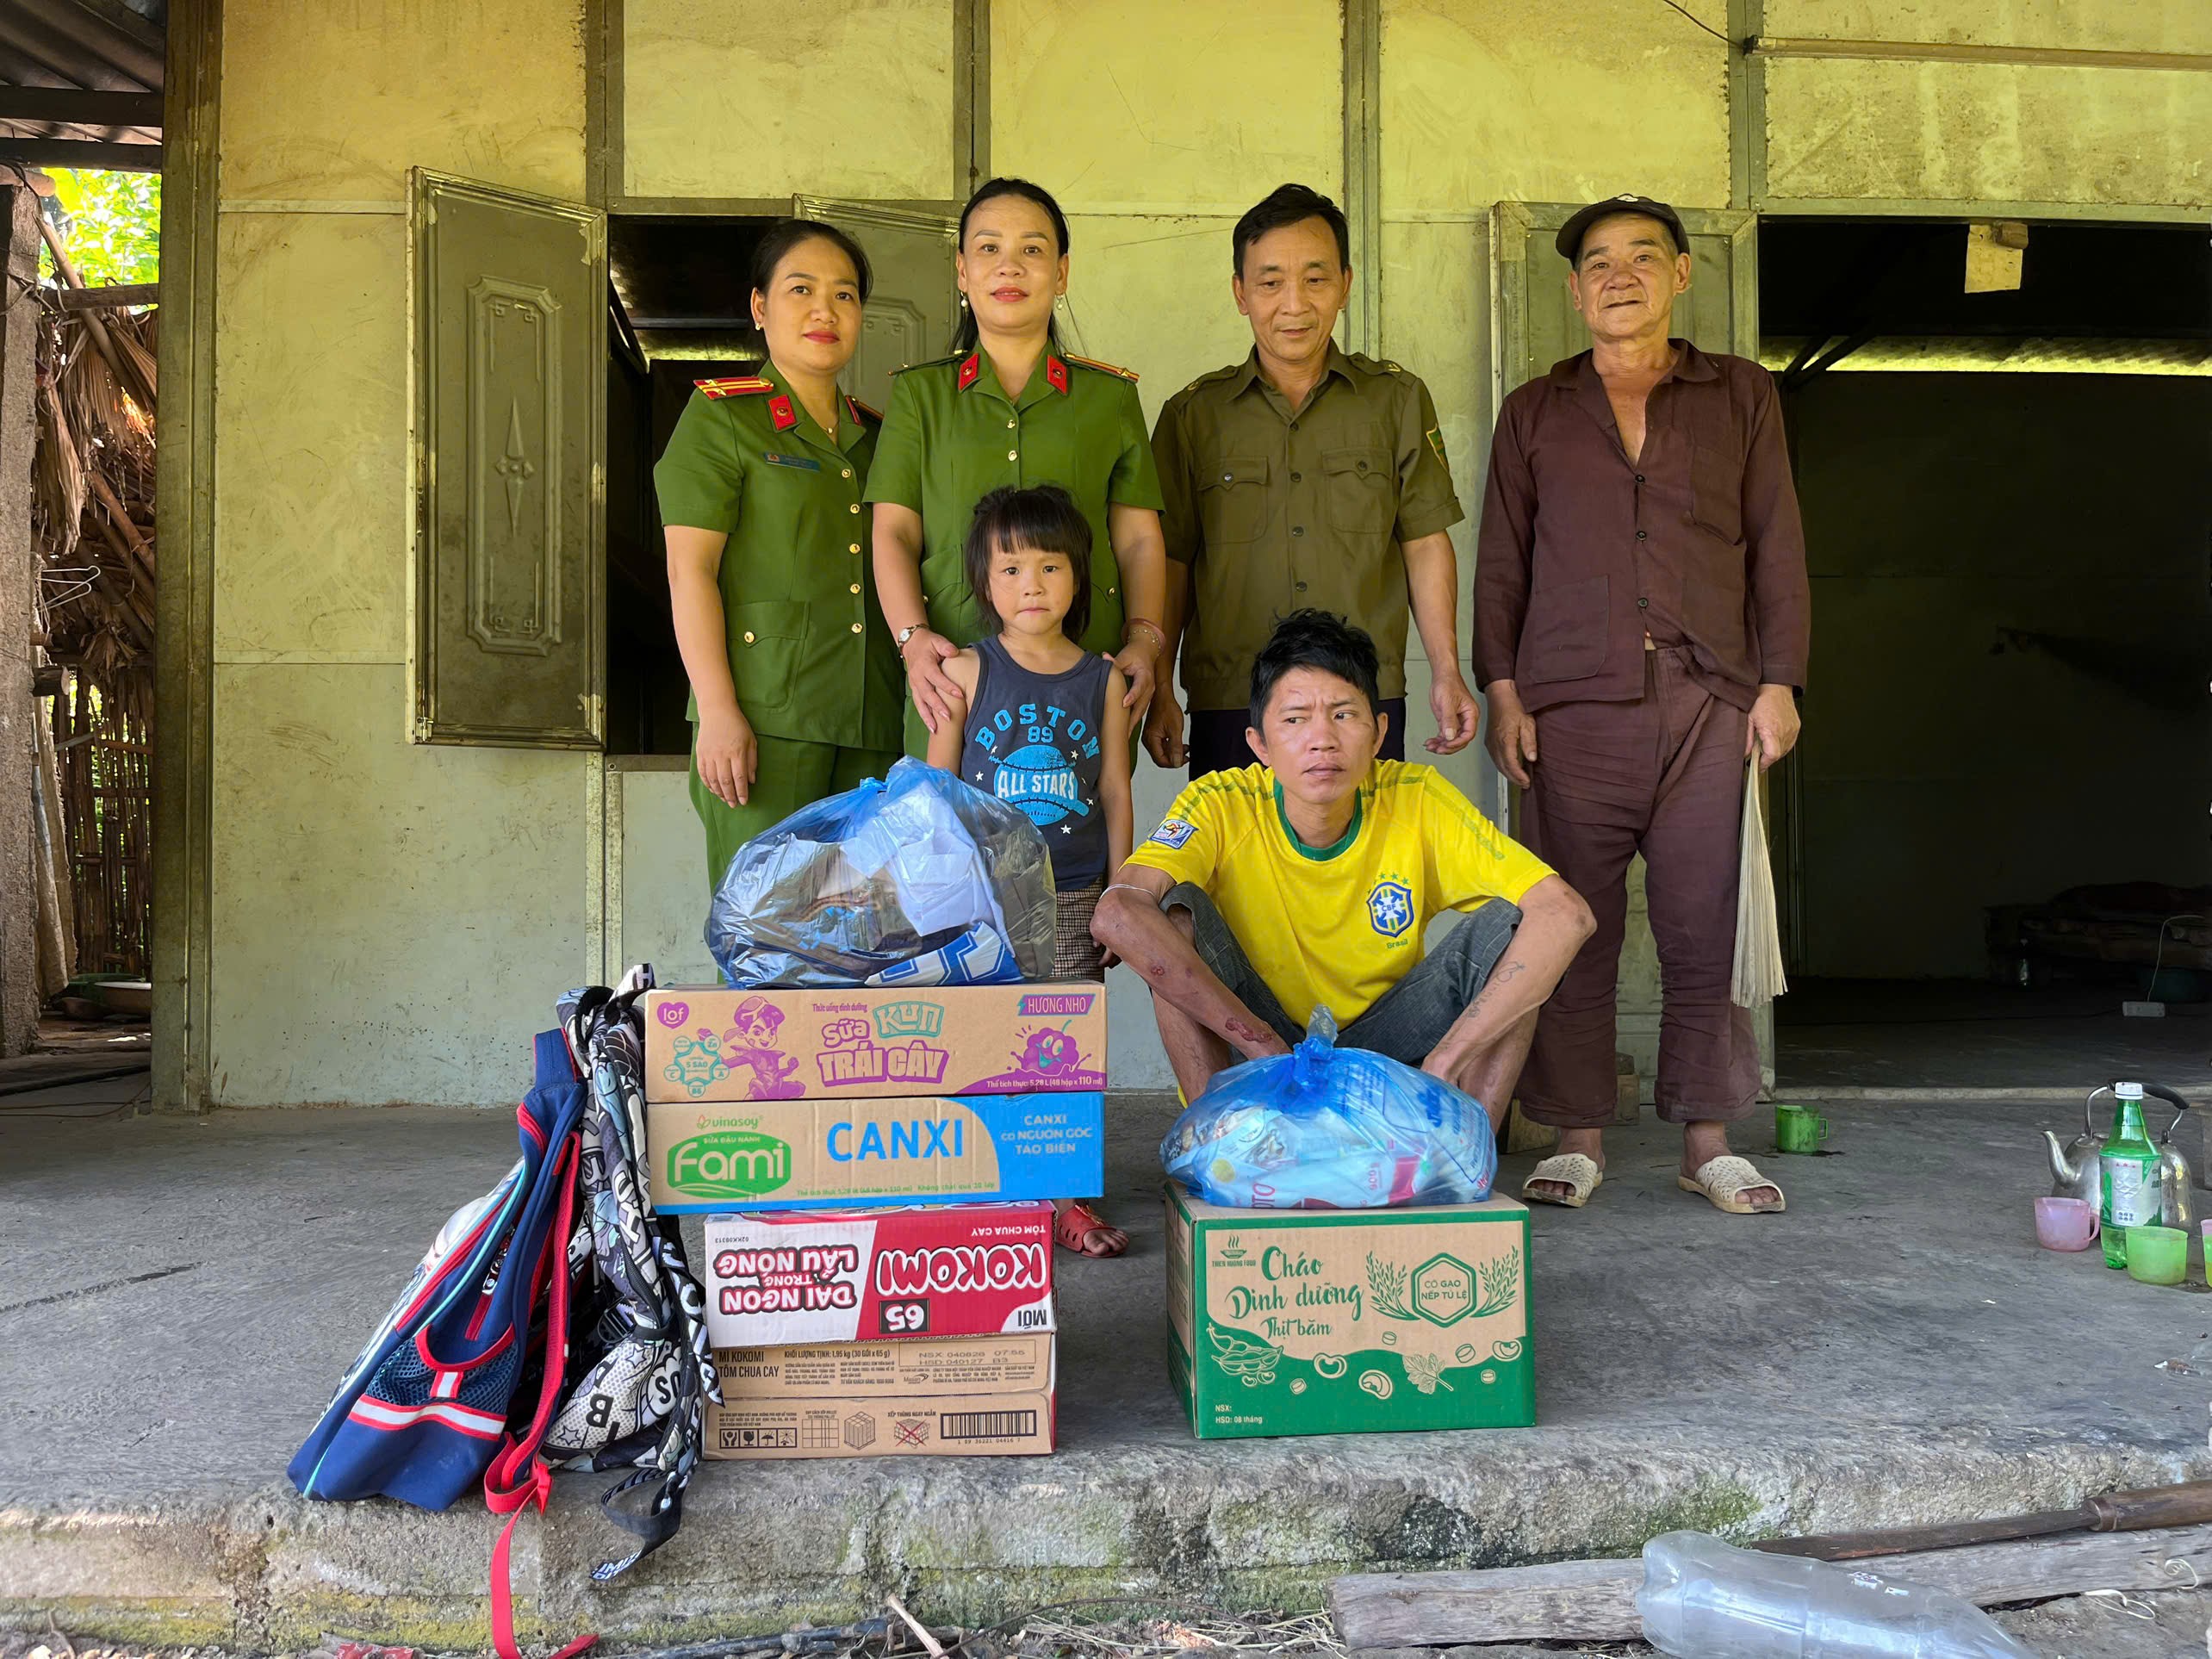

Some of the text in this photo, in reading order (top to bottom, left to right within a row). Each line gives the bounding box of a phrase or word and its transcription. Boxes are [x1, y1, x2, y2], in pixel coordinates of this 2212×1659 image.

[975, 703, 1100, 760] BOSTON
[997, 771, 1076, 800] ALL STARS
[1381, 903, 1396, 912] CBF
[1387, 938, 1408, 949] Brasil
[1028, 996, 1085, 1013] HƯƠNG NHO
[663, 1007, 684, 1022] lof
[817, 1041, 948, 1084] TRÁI CÂY
[1078, 1076, 1091, 1085] 110
[712, 1116, 759, 1129] vinasoy
[1023, 1114, 1067, 1126] CANXI
[826, 1120, 963, 1162] CANXI
[674, 1141, 785, 1183] fami
[971, 1224, 1047, 1237] TÔM CHUA CAY
[716, 1248, 797, 1279] NÓNG
[875, 1242, 1047, 1297] KOKOMI
[1261, 1246, 1323, 1281] Cháo
[764, 1274, 813, 1288] TRONG
[721, 1287, 855, 1314] DAI NGON
[1224, 1282, 1364, 1321] Dinh dưỡng
[885, 1302, 926, 1333] 65
[1017, 1308, 1047, 1330] MỚI
[1260, 1316, 1333, 1339] Thịt băm
[732, 1351, 764, 1363] KOKOMI
[843, 1350, 851, 1359] kg
[718, 1365, 738, 1378] TÔM
[739, 1365, 761, 1378] CHUA
[763, 1365, 780, 1378] CAY
[1215, 1404, 1232, 1413] NSX:
[1215, 1415, 1233, 1424] HSD:
[1243, 1414, 1263, 1425] tháng
